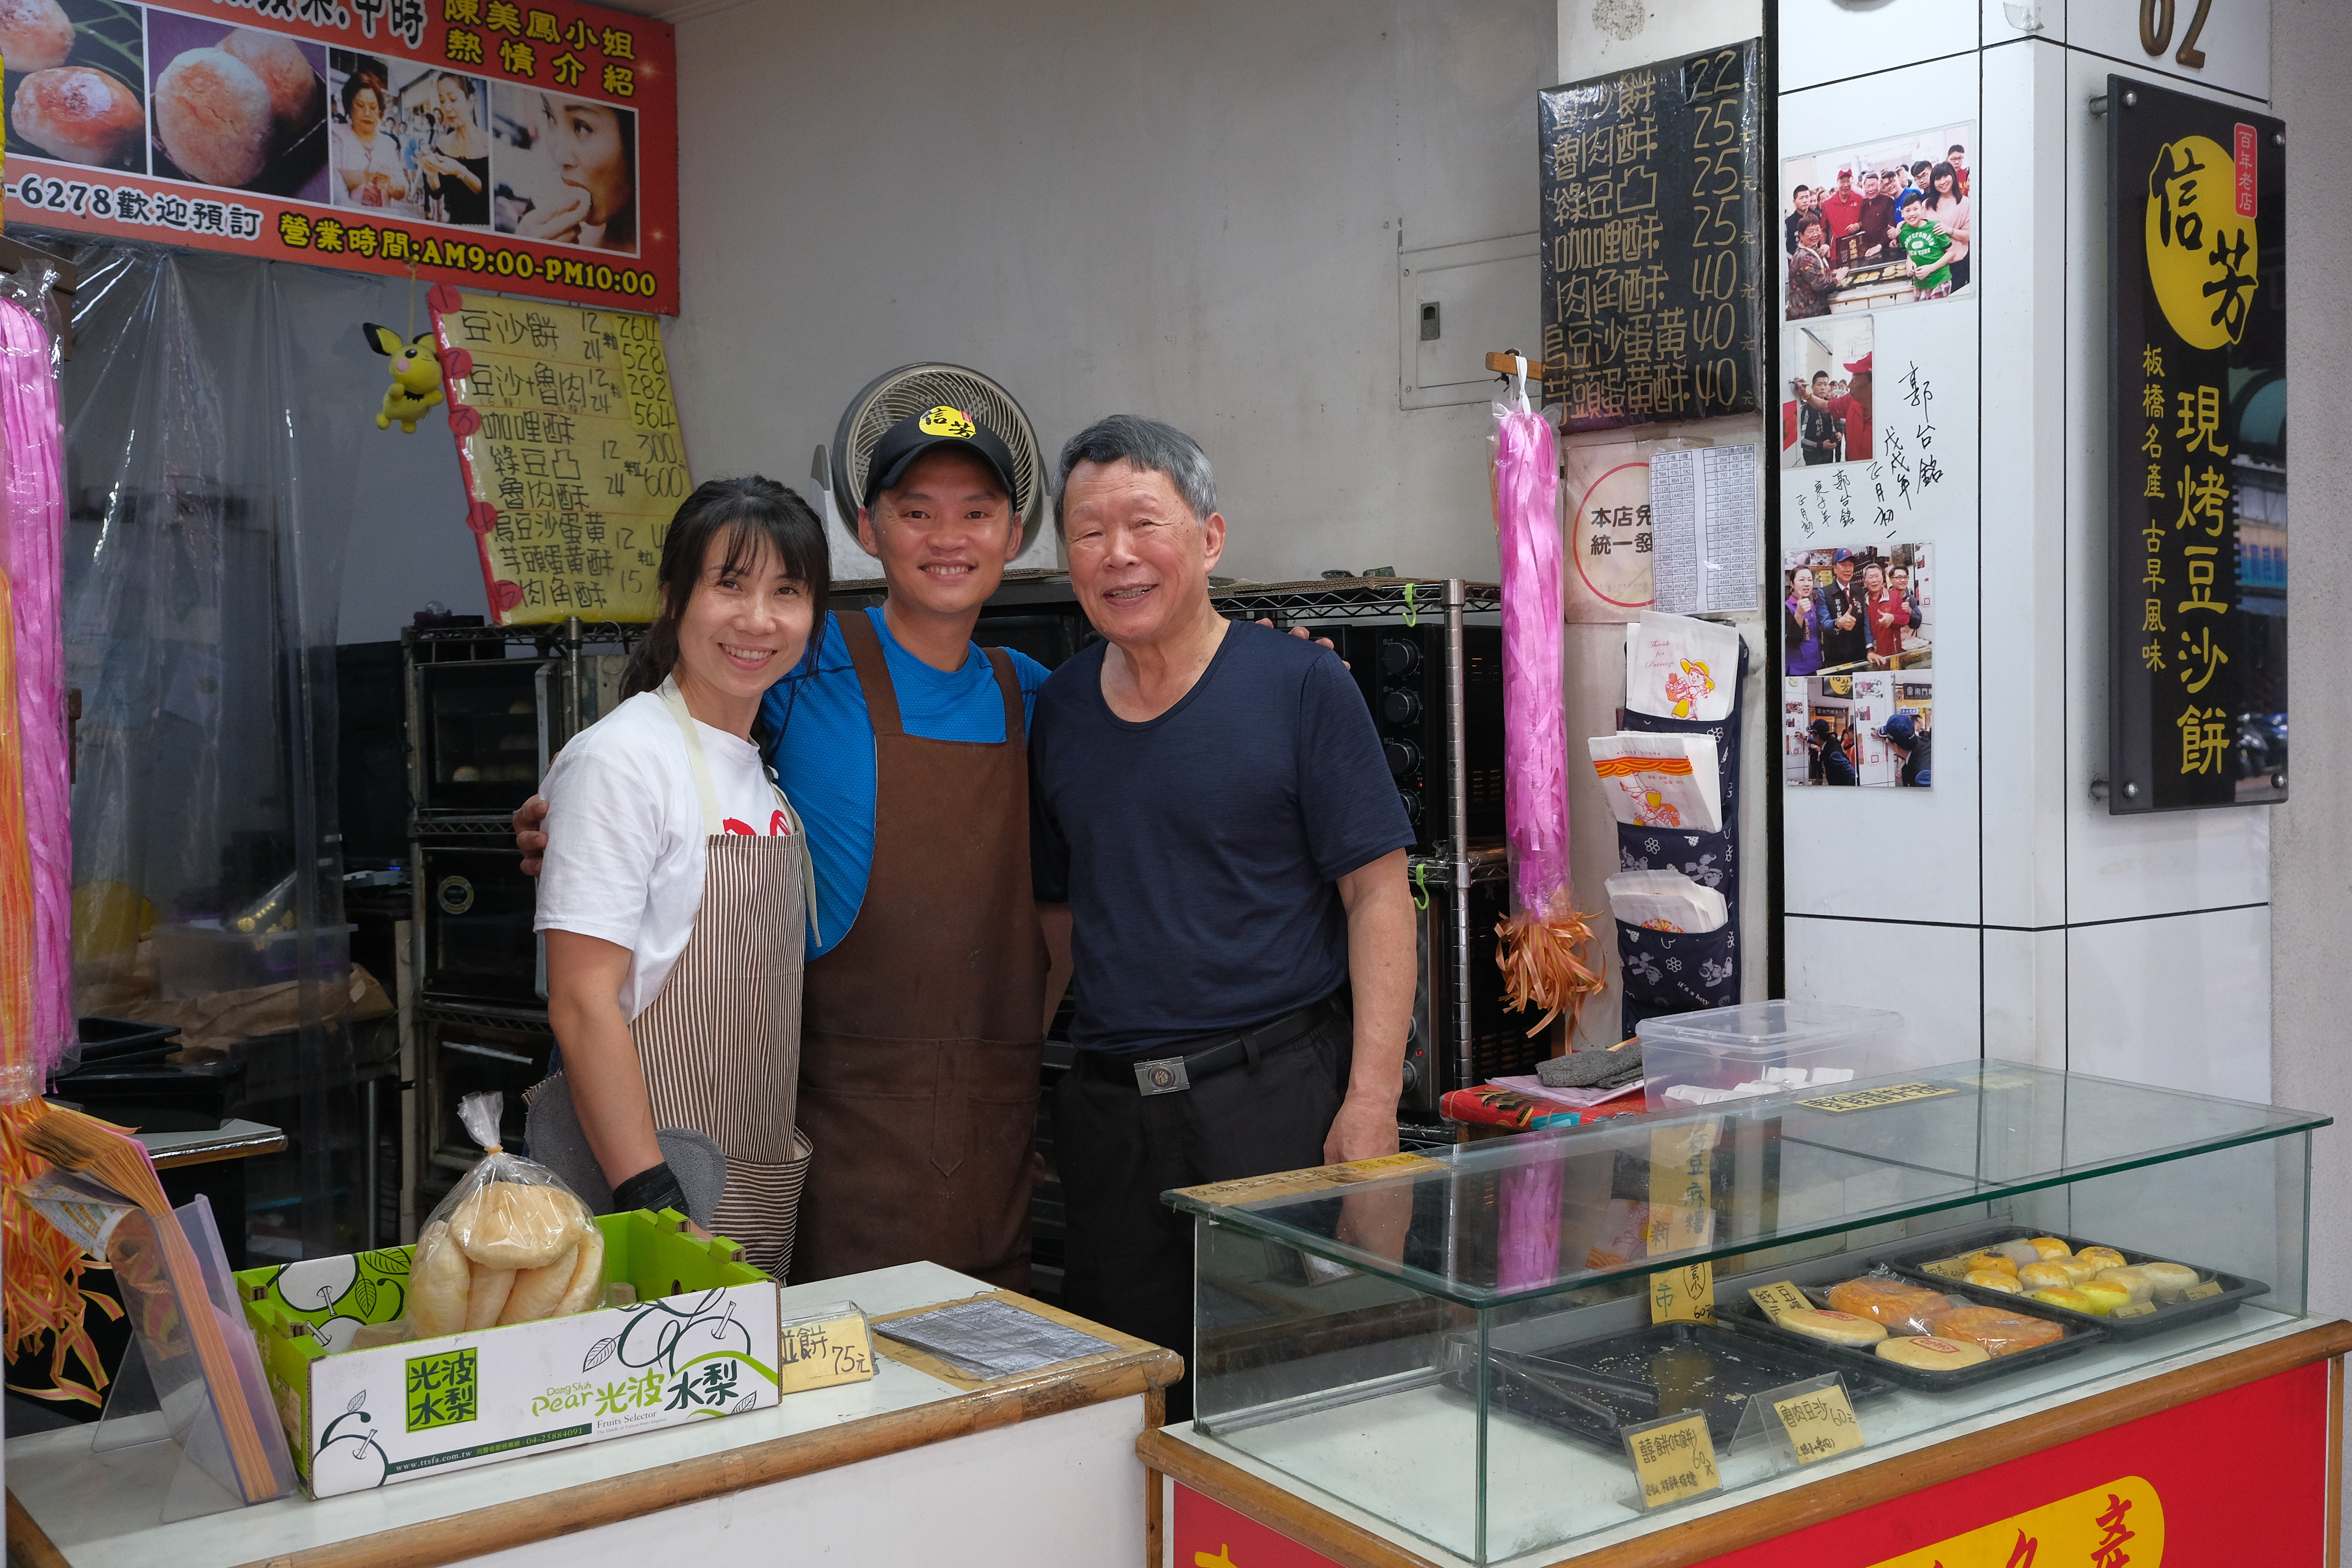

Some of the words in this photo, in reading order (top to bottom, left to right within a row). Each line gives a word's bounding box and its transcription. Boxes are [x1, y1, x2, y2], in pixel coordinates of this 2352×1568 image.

[447, 28, 635, 96] 熱情介紹
[1693, 50, 1739, 97] 22
[1554, 116, 1657, 180] 魯肉酥
[1693, 100, 1737, 148] 25
[1693, 149, 1740, 196] 25
[2239, 130, 2252, 211] 百年老店
[1693, 196, 1740, 247] 25
[1740, 231, 1755, 244] 元
[2151, 147, 2256, 342] 信芳
[1693, 250, 1736, 300] 40
[1740, 284, 1755, 299] 元
[461, 310, 558, 349] 豆沙餅
[581, 312, 600, 334] 12
[617, 315, 658, 344] 264
[1694, 303, 1735, 350] 40
[583, 341, 603, 361] 24
[623, 346, 665, 374] 528
[589, 369, 609, 387] 12
[628, 374, 667, 401] 282
[1696, 358, 1736, 405] 40
[482, 412, 575, 445] 咖哩酥
[591, 395, 611, 413] 24
[634, 403, 675, 429] 564
[922, 408, 975, 438] 信芳
[2141, 343, 2166, 499] 板橋名產
[490, 445, 580, 479] 綠豆凸
[603, 440, 620, 459] 12
[499, 478, 589, 510] 魯肉酥
[605, 476, 624, 497] 24
[644, 468, 683, 498] 600
[617, 528, 634, 549] 12
[2142, 519, 2166, 672] 古早風味
[2176, 384, 2230, 775] 現烤豆沙餅
[1651, 1220, 1674, 1318] 新市
[409, 1351, 476, 1393] 光波
[832, 1345, 870, 1375] 75元
[410, 1386, 475, 1427] 水梨
[547, 1386, 571, 1396] Dong
[572, 1381, 591, 1392] Shih
[597, 1417, 622, 1429] Fruits
[623, 1411, 657, 1424] Selector
[1830, 1408, 1856, 1426] 60元
[396, 1449, 472, 1472] www.ttsfa.com.tw
[526, 1427, 582, 1445] 04-25884091
